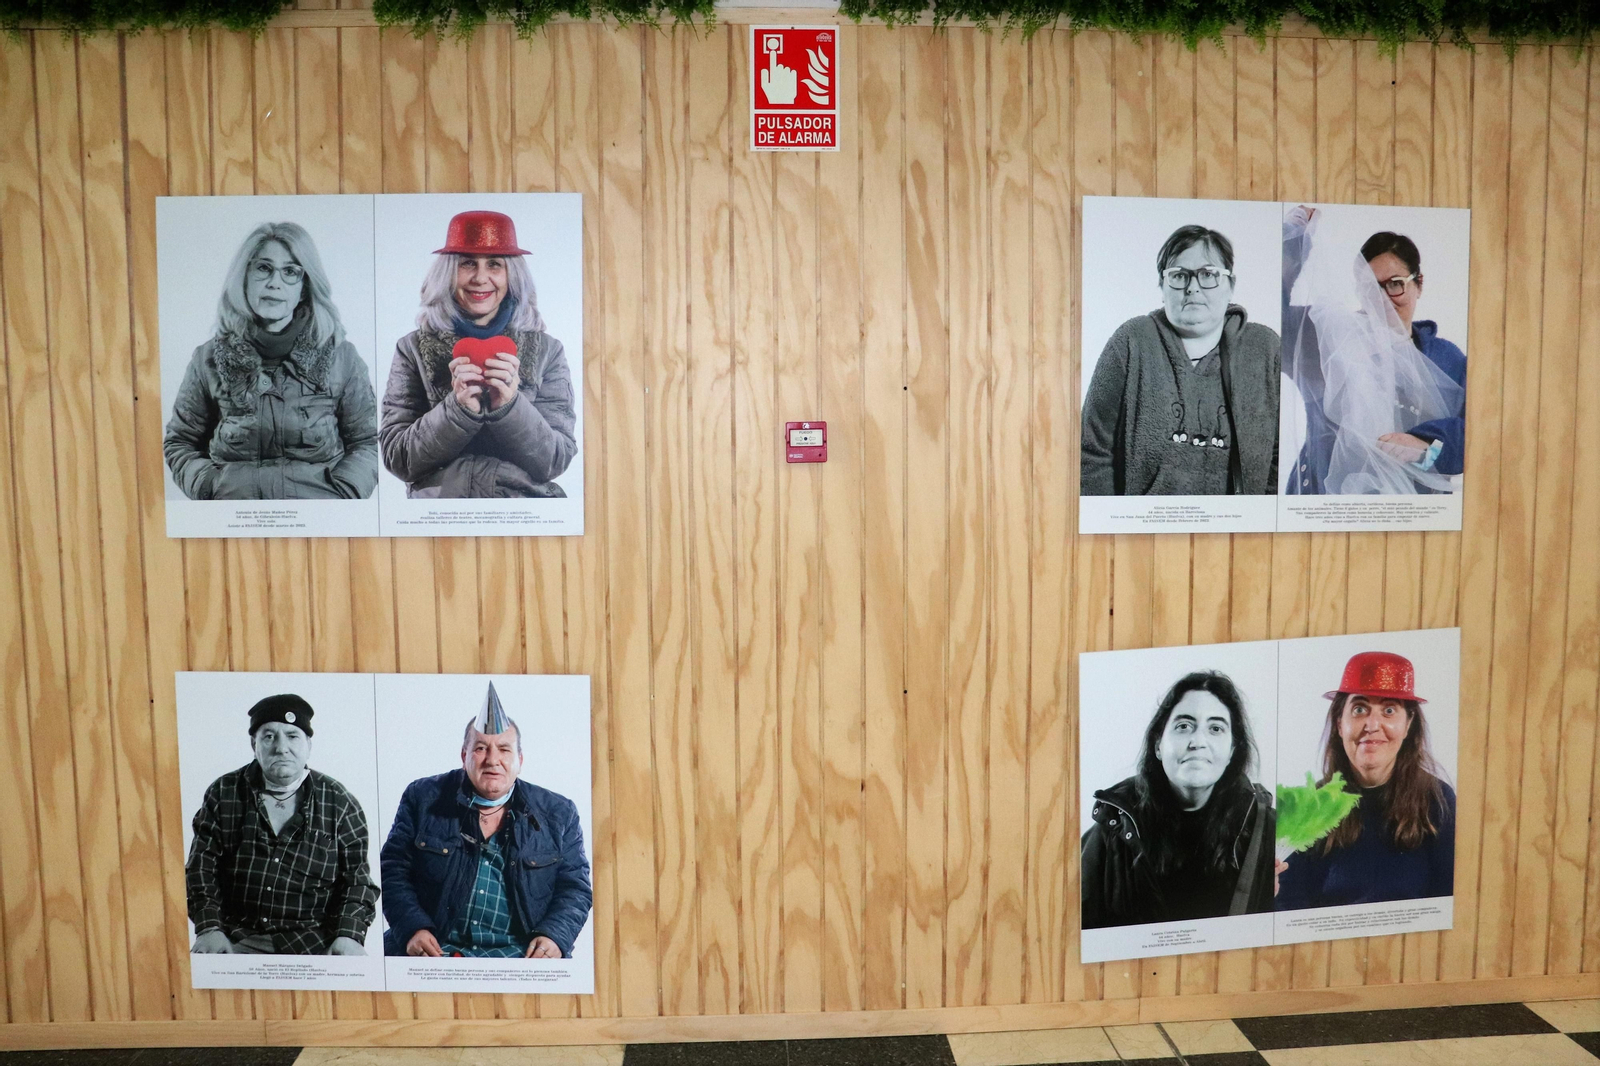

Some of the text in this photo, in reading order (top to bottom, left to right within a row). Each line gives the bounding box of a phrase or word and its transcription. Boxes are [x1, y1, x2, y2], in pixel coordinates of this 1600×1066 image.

[758, 117, 832, 129] PULSADOR
[758, 132, 832, 144] DE ALARMA
